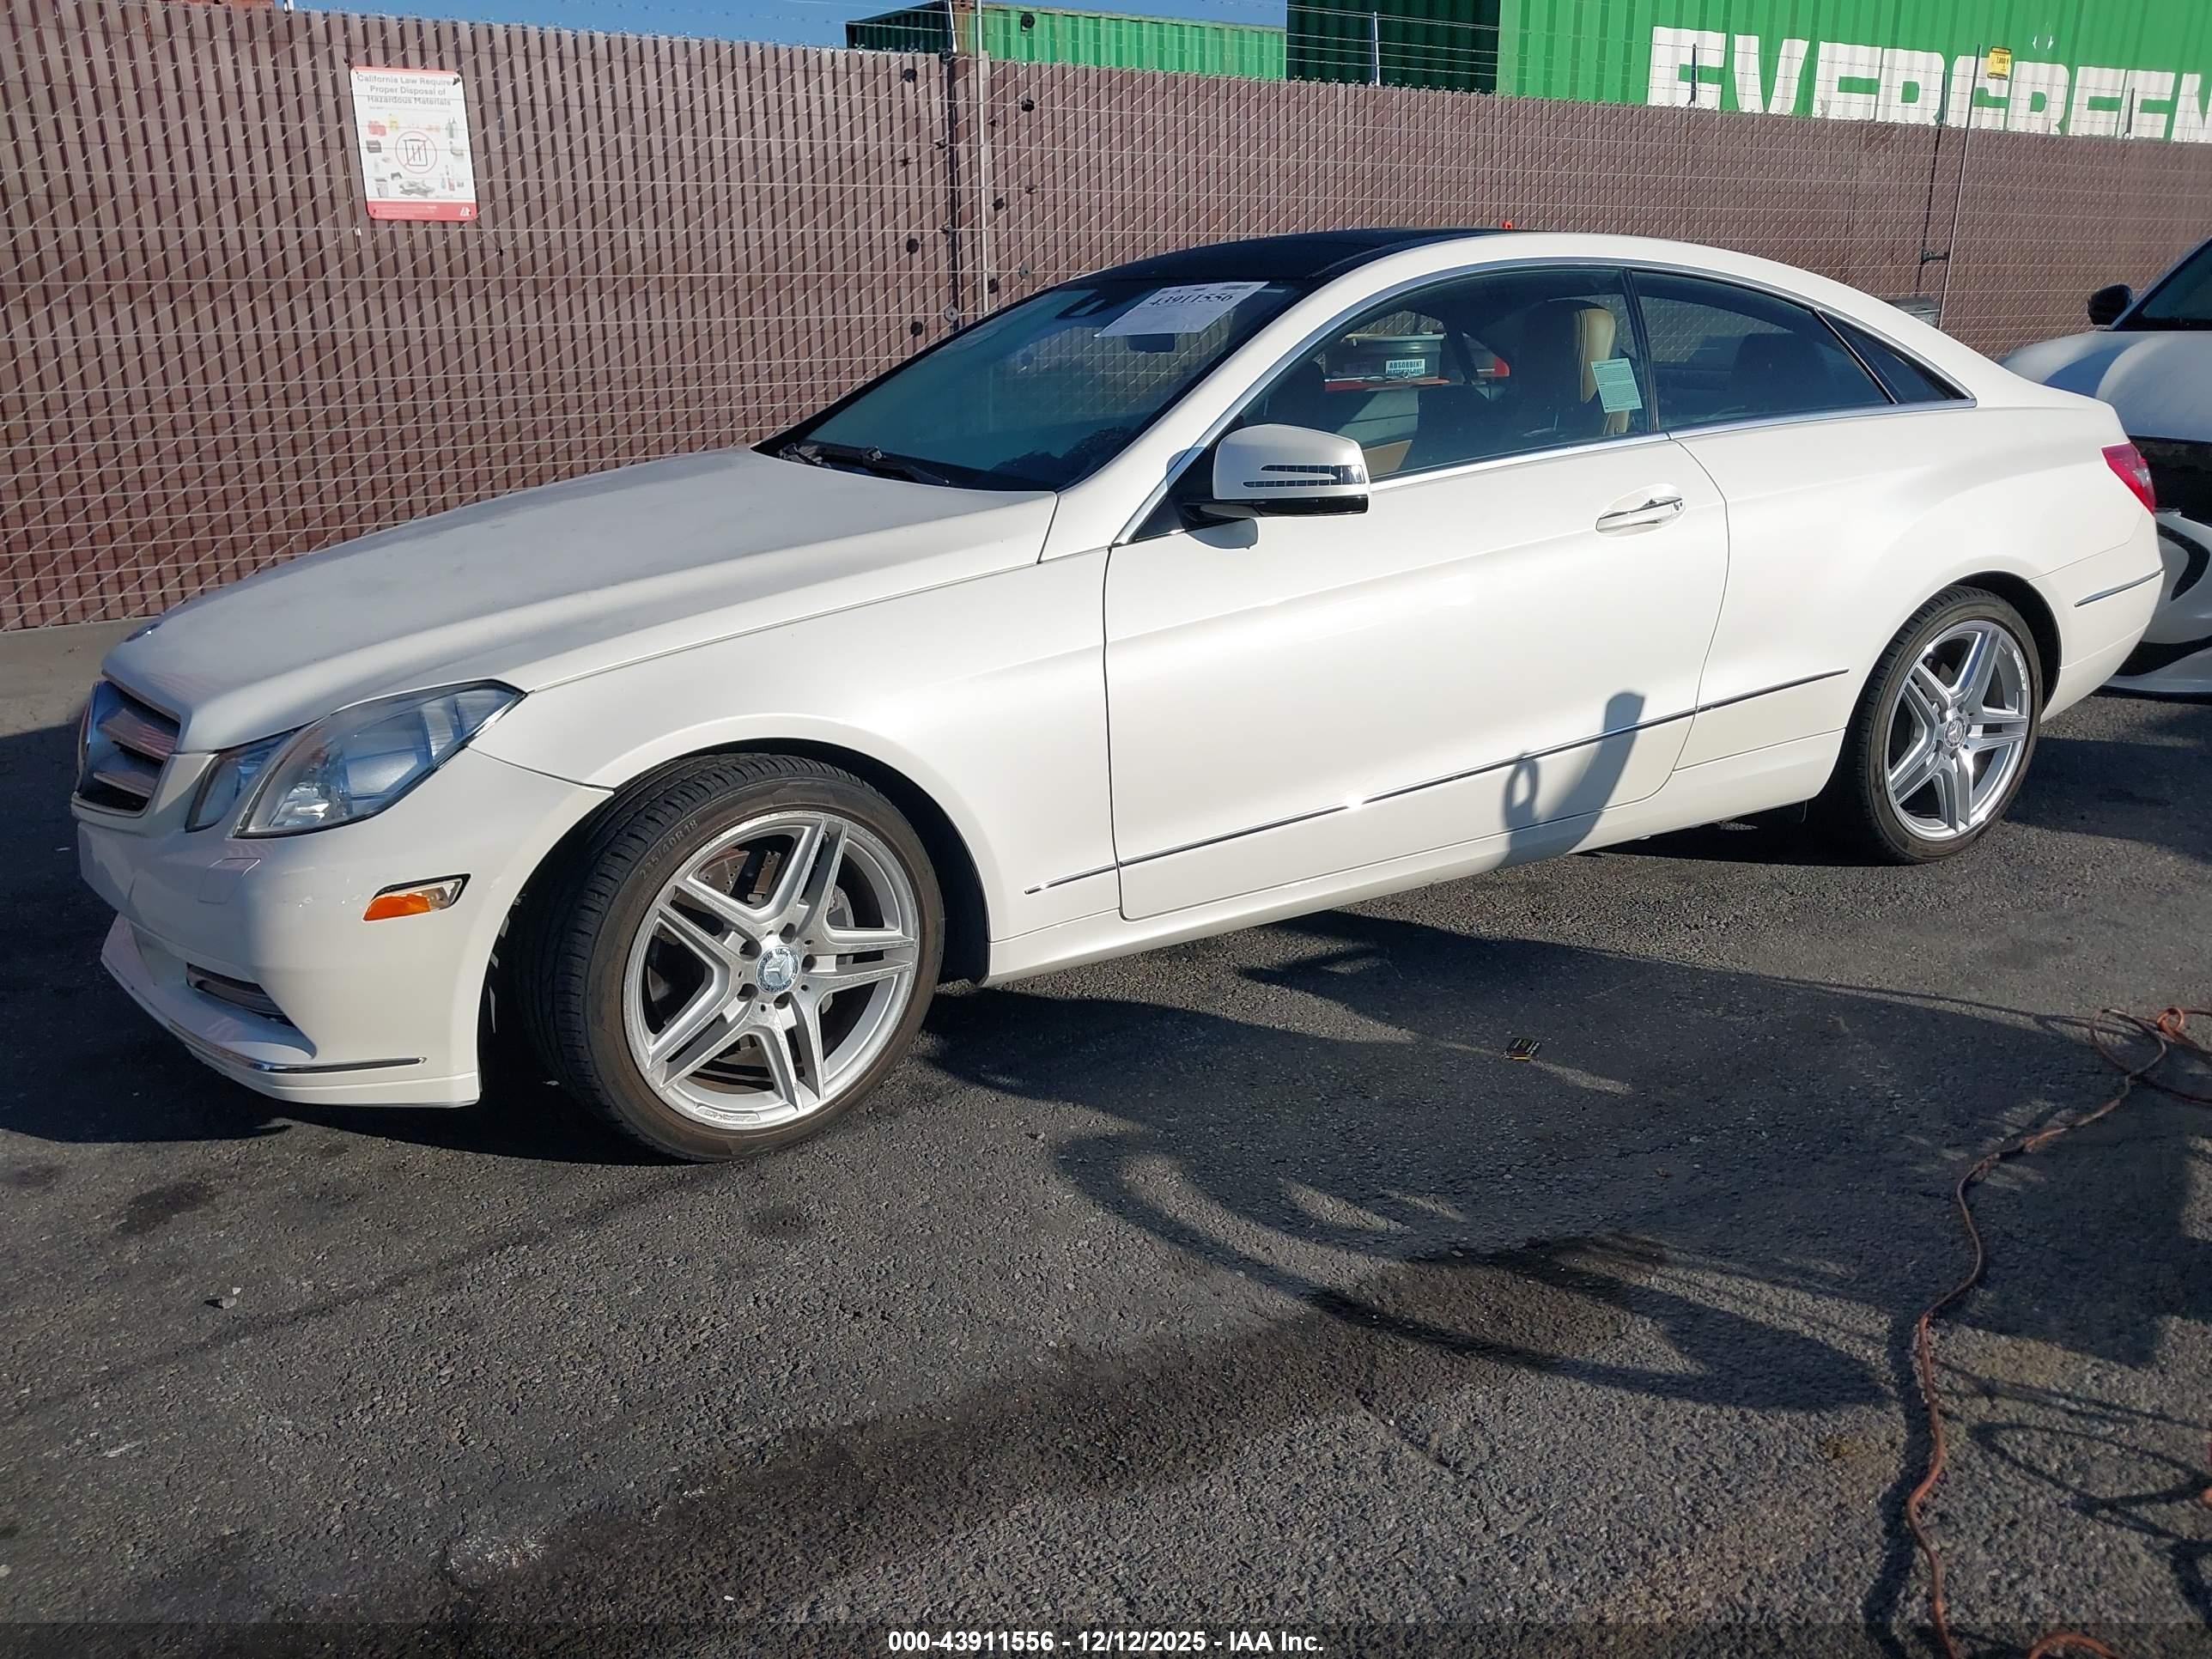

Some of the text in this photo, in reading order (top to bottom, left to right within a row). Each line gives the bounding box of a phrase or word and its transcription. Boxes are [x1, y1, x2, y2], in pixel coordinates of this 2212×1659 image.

[356, 74, 398, 83] California
[370, 85, 398, 94] Proper
[400, 86, 435, 95] Disposal
[368, 94, 451, 106] Hazardous Materials
